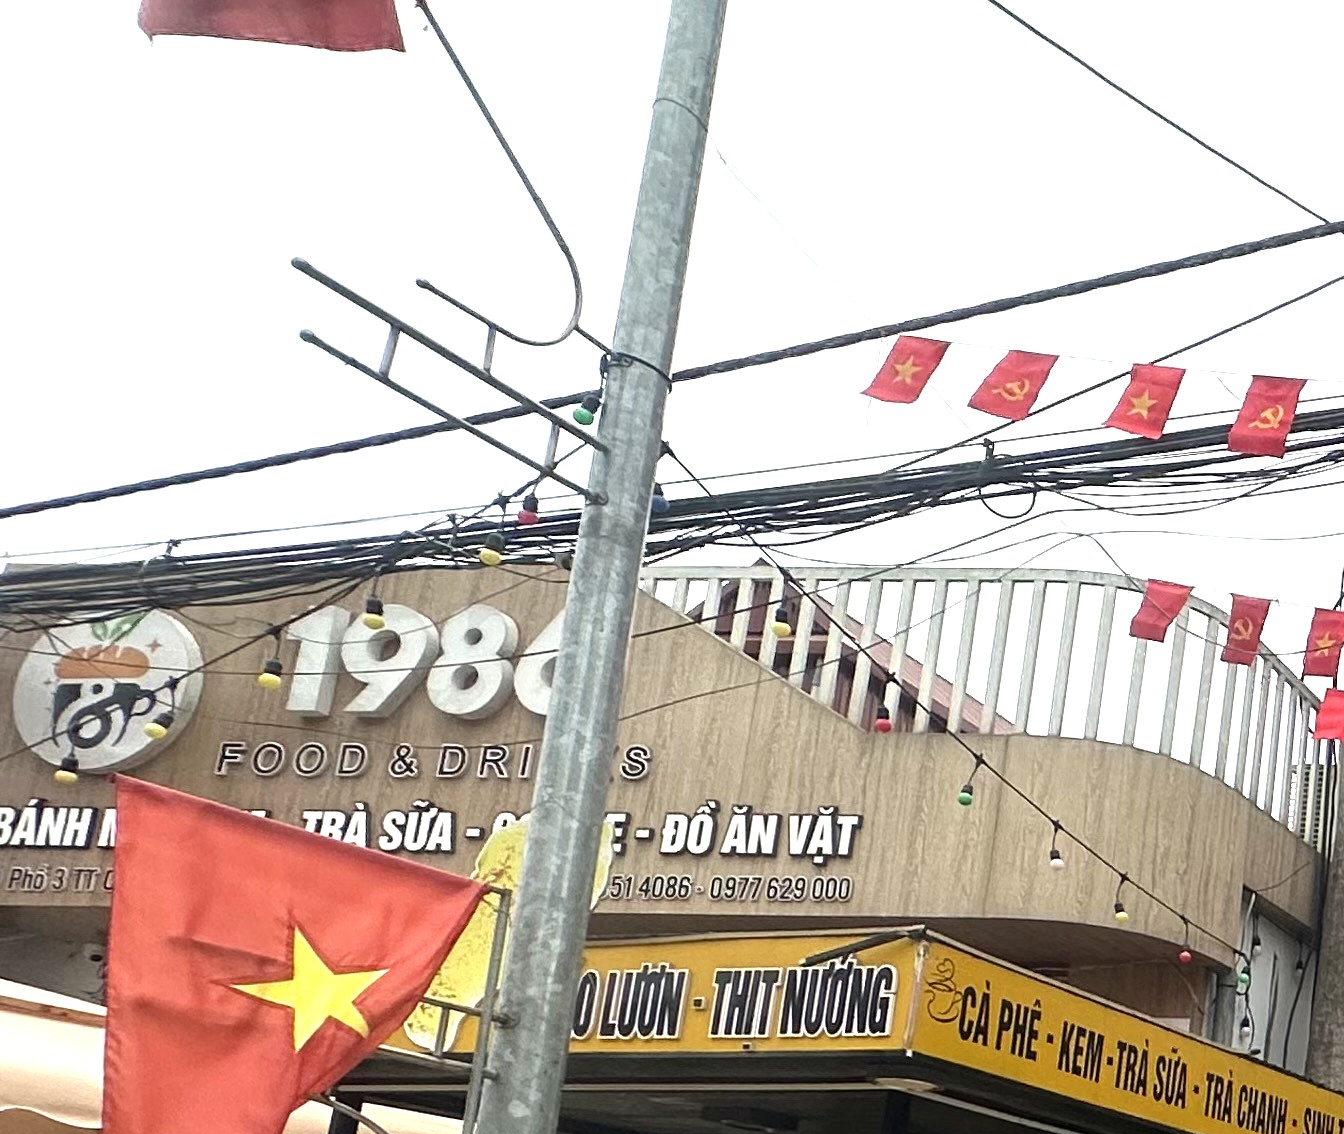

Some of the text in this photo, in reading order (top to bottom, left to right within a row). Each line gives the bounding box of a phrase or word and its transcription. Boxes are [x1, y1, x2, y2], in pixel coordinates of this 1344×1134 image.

[214, 740, 368, 776] FOOD
[435, 742, 652, 780] DRIS
[378, 800, 455, 854] SỮA
[660, 800, 720, 855] ĐỒ
[720, 806, 778, 857] ĂN
[788, 806, 861, 865] VẶT
[7, 864, 48, 892] Phố
[50, 867, 66, 891] 3
[708, 876, 763, 899] 0977
[811, 877, 852, 900] 000
[957, 980, 992, 1046] CÀ
[999, 1002, 1042, 1062] PHÊ
[1058, 1019, 1103, 1083] KEM
[1115, 1038, 1150, 1099] TRÀ
[1153, 1045, 1188, 1109] SỮA
[1205, 1070, 1232, 1124] TRÀ
